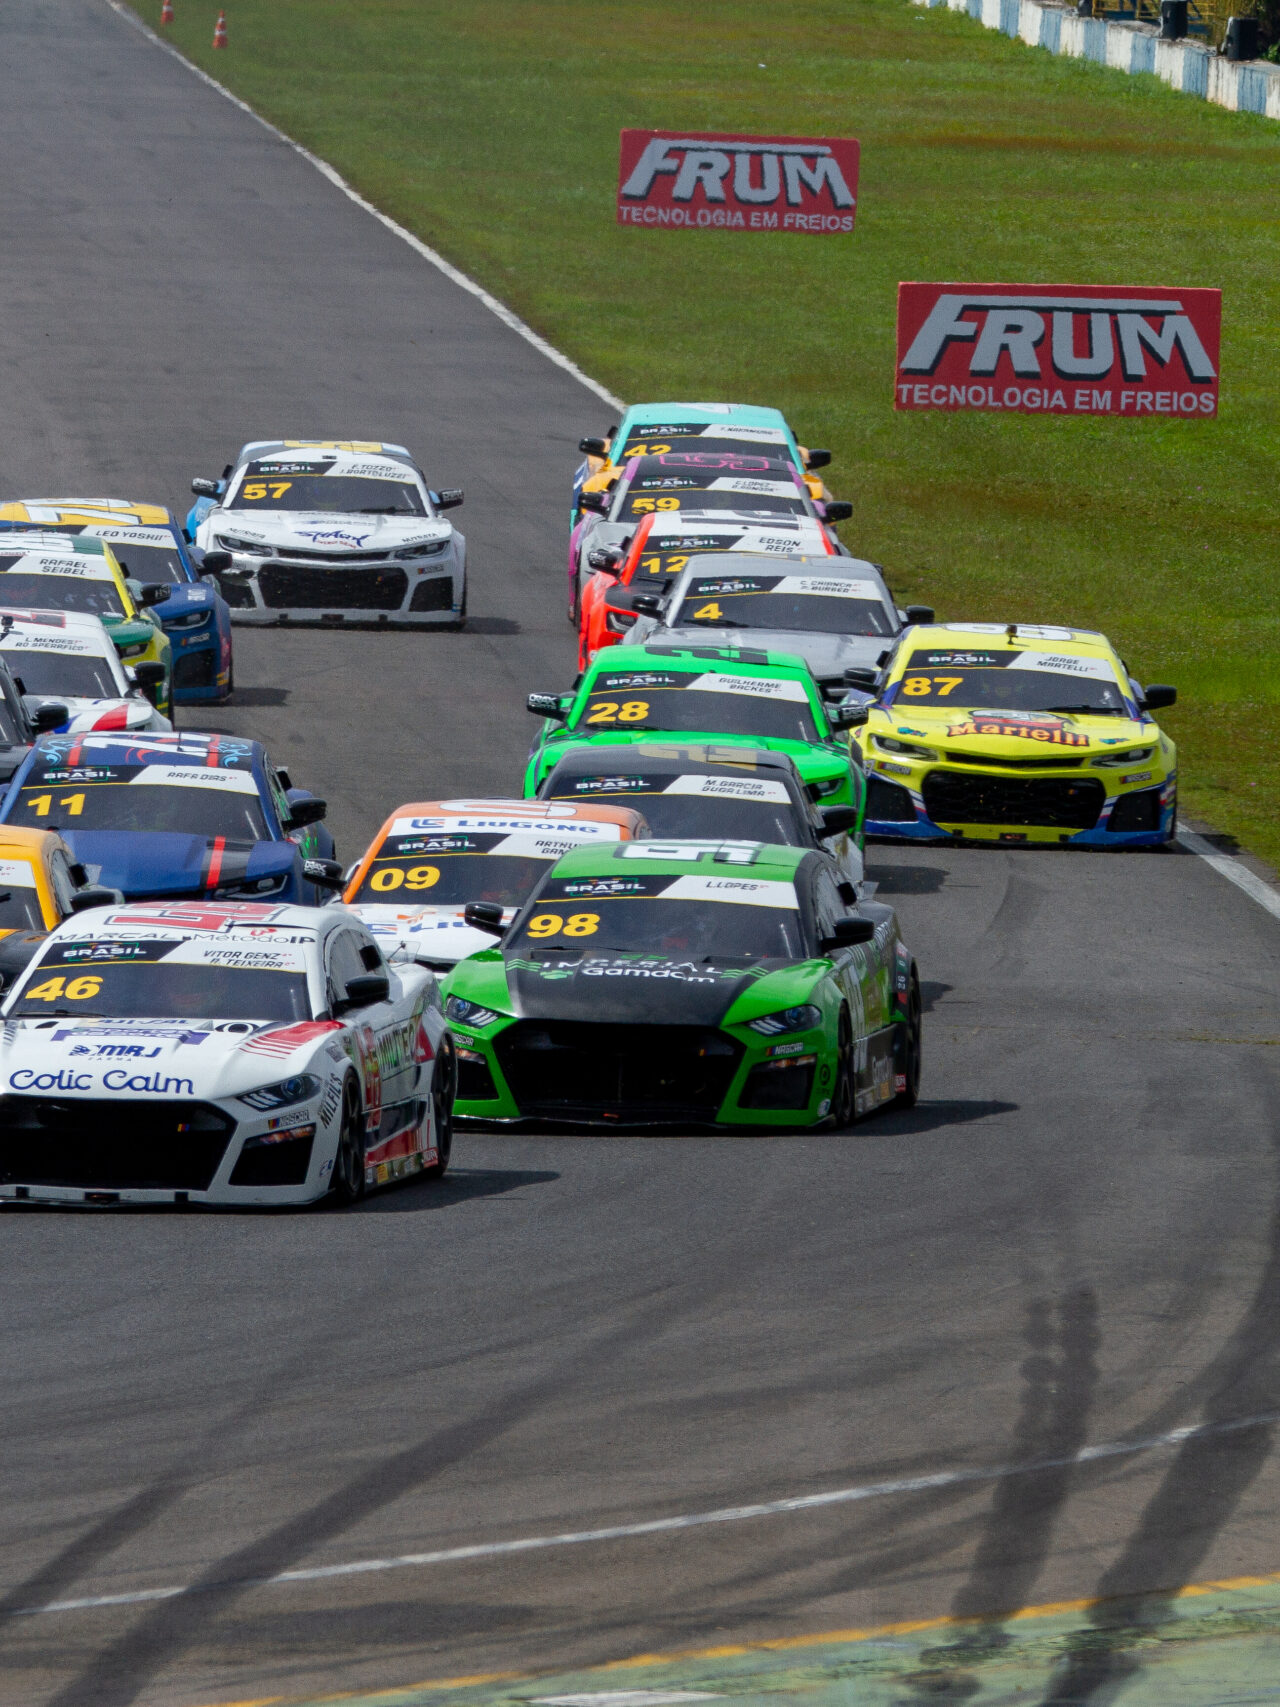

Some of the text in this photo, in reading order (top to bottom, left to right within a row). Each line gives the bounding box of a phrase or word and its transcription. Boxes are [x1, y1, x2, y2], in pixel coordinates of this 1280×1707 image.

[620, 138, 856, 208] FRUM
[620, 206, 854, 232] TECNOLOGIA EM FREIOS
[899, 294, 1217, 381] FRUM
[898, 383, 1216, 414] TECNOLOGIA EM FREIOS
[640, 427, 691, 435] BRASIL
[624, 444, 671, 456] 42
[259, 464, 315, 473] BRASIL
[242, 482, 293, 500] 57
[631, 497, 680, 514] 59
[95, 530, 119, 539] LEO
[659, 538, 719, 547] BRASIL
[757, 537, 800, 547] EDSON
[764, 544, 793, 552] REIS
[40, 558, 88, 569] RAFAEL
[640, 555, 688, 573] 12
[42, 566, 85, 576] SEIBEL
[697, 582, 760, 591] BRASIL
[693, 603, 723, 620] 4
[927, 653, 997, 663] BRASIL
[1045, 655, 1079, 665] JORGE
[1036, 660, 1088, 672] MARTELLI
[606, 674, 675, 685] BRASIL
[719, 676, 782, 688] GUILHERME
[902, 676, 964, 696] 87
[586, 700, 649, 722] 28
[948, 721, 1089, 746] Martelli
[44, 769, 119, 780] BRASIL
[168, 771, 228, 782] RAFA DIAS
[576, 779, 650, 789] BRASIL
[732, 787, 765, 796] LIMA
[27, 793, 86, 816] 11
[398, 839, 477, 851] BRASIL
[370, 865, 440, 892] 09
[563, 881, 646, 892] BRASIL
[527, 913, 600, 937] 98
[63, 948, 147, 958] BRASIL
[204, 951, 281, 960] VITOR GENZ
[224, 960, 283, 970] TEIXEIRA
[25, 975, 104, 1001] 46
[9, 1069, 195, 1095] Colic Calm
